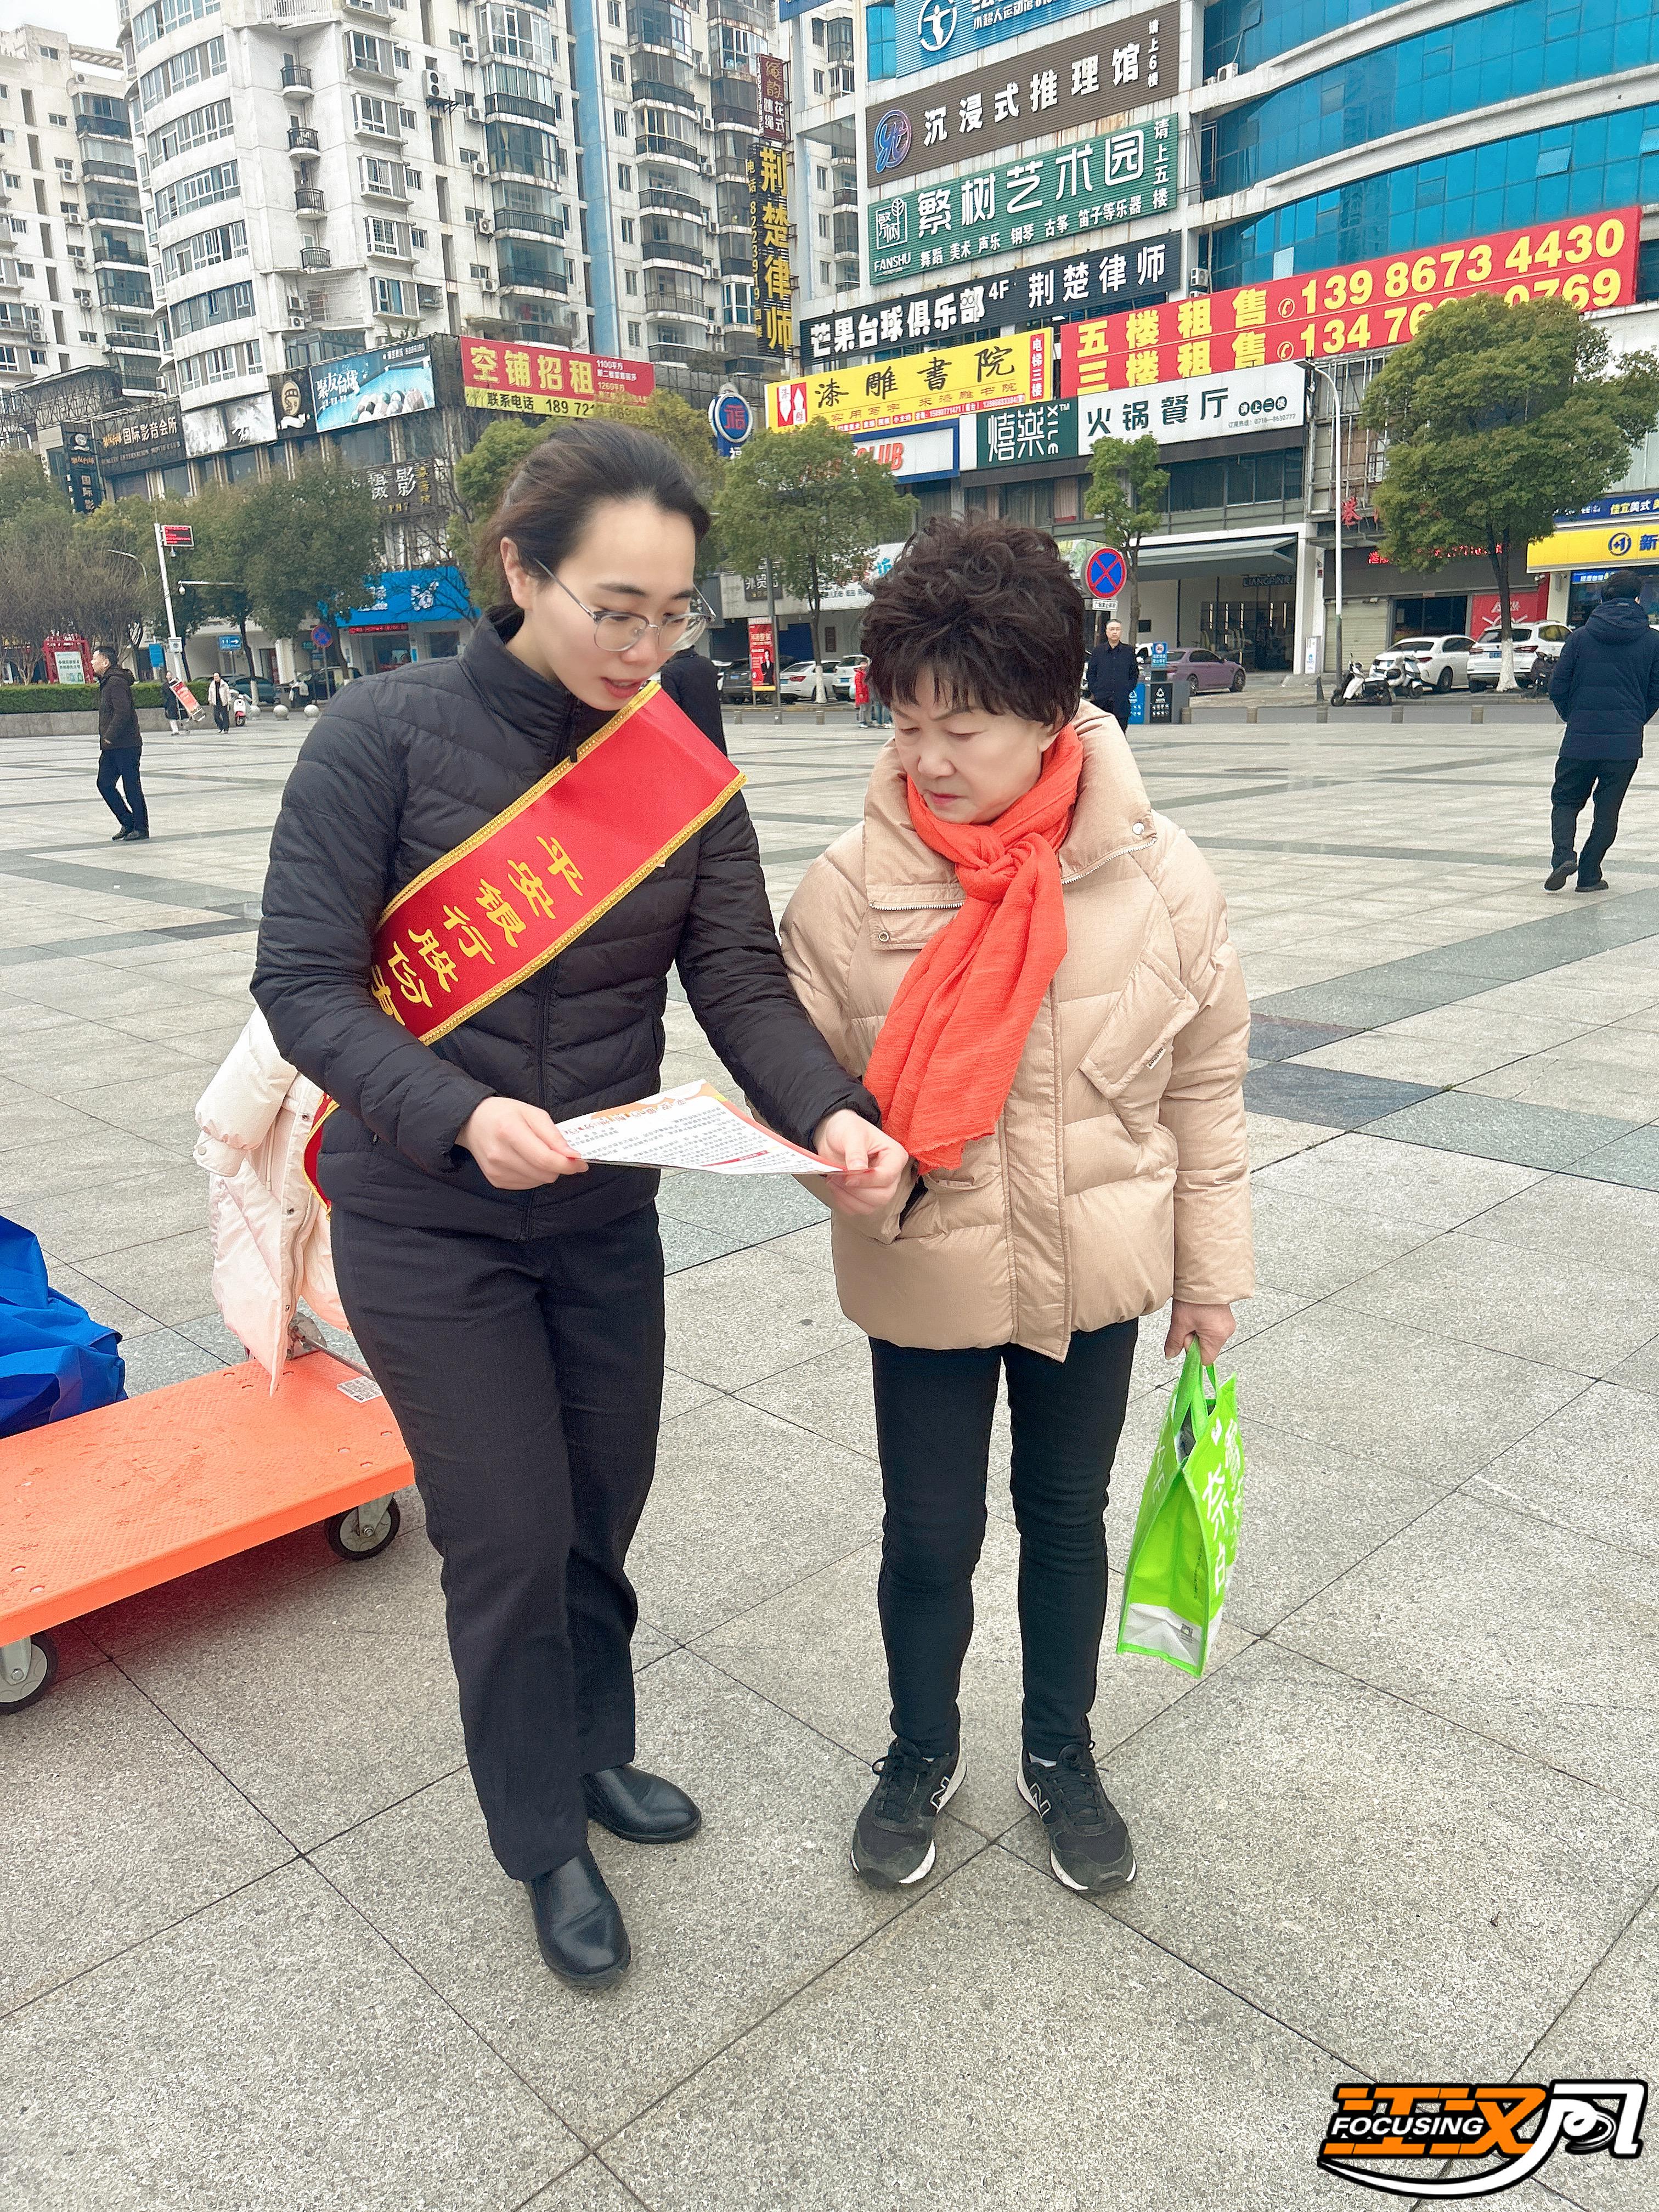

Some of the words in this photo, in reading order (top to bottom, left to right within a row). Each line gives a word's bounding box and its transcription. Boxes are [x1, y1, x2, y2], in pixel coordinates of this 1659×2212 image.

[1148, 19, 1159, 88] 请上6楼
[923, 43, 1139, 146] 沉浸式推理馆
[746, 160, 757, 193] 电话
[917, 129, 1144, 239] 繁树艺术园
[1152, 119, 1169, 209] 请上五楼
[750, 201, 760, 301] 8223919
[760, 147, 792, 352] 荆楚律师
[874, 252, 911, 273] FANSHU
[921, 247, 944, 268] 舞蹈
[950, 240, 972, 262] 美术
[978, 232, 1001, 254] 声乐
[1011, 223, 1034, 245] 钢琴
[1045, 214, 1069, 238] 古筝
[1079, 194, 1142, 228] 笛子等乐器
[1028, 244, 1166, 308] 荆楚律师
[1077, 289, 1267, 358] 五楼租售
[1302, 269, 1373, 314] 139
[1384, 245, 1493, 298] 8673
[1505, 219, 1625, 273] 4430
[810, 285, 985, 358] 芒果台球俱乐部
[989, 279, 1009, 301] 4F
[470, 346, 595, 394] 空铺招租
[815, 346, 1015, 408] 漆雕書院
[1031, 337, 1043, 398] 电梯三楼
[1077, 332, 1266, 396] 三楼租售
[1300, 314, 1372, 357] 134
[123, 416, 177, 445] 国际影音会所
[487, 392, 534, 410] 联系电话
[546, 399, 568, 414] 189
[1059, 403, 1070, 411] TM
[1087, 388, 1228, 437] 火锅餐厅
